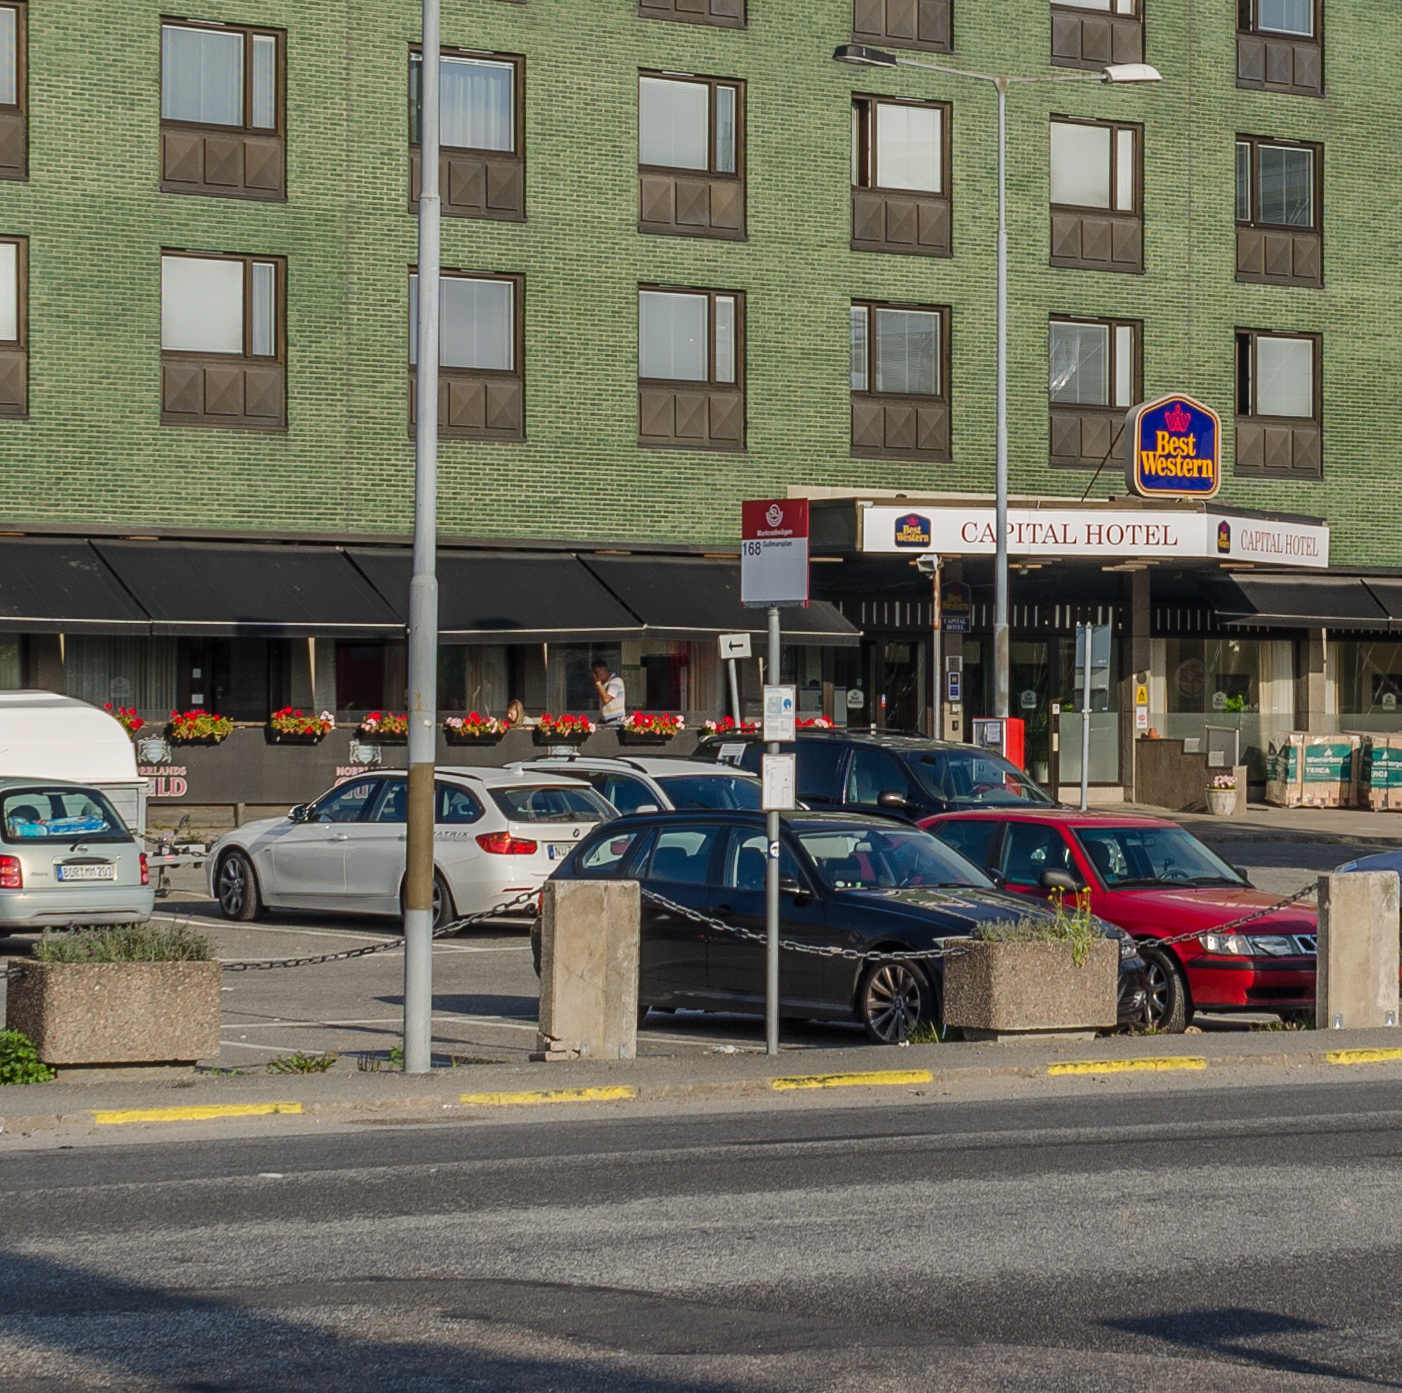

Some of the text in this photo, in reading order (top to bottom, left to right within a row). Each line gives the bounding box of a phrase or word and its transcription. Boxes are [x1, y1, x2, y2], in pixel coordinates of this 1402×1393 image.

[1156, 430, 1196, 456] Best
[1141, 451, 1214, 477] Western
[897, 532, 929, 543] Western
[903, 524, 921, 534] Best
[1084, 524, 1178, 546] HOTEL
[743, 541, 762, 556] 168
[1240, 529, 1318, 557] CAPITAL HOTEL
